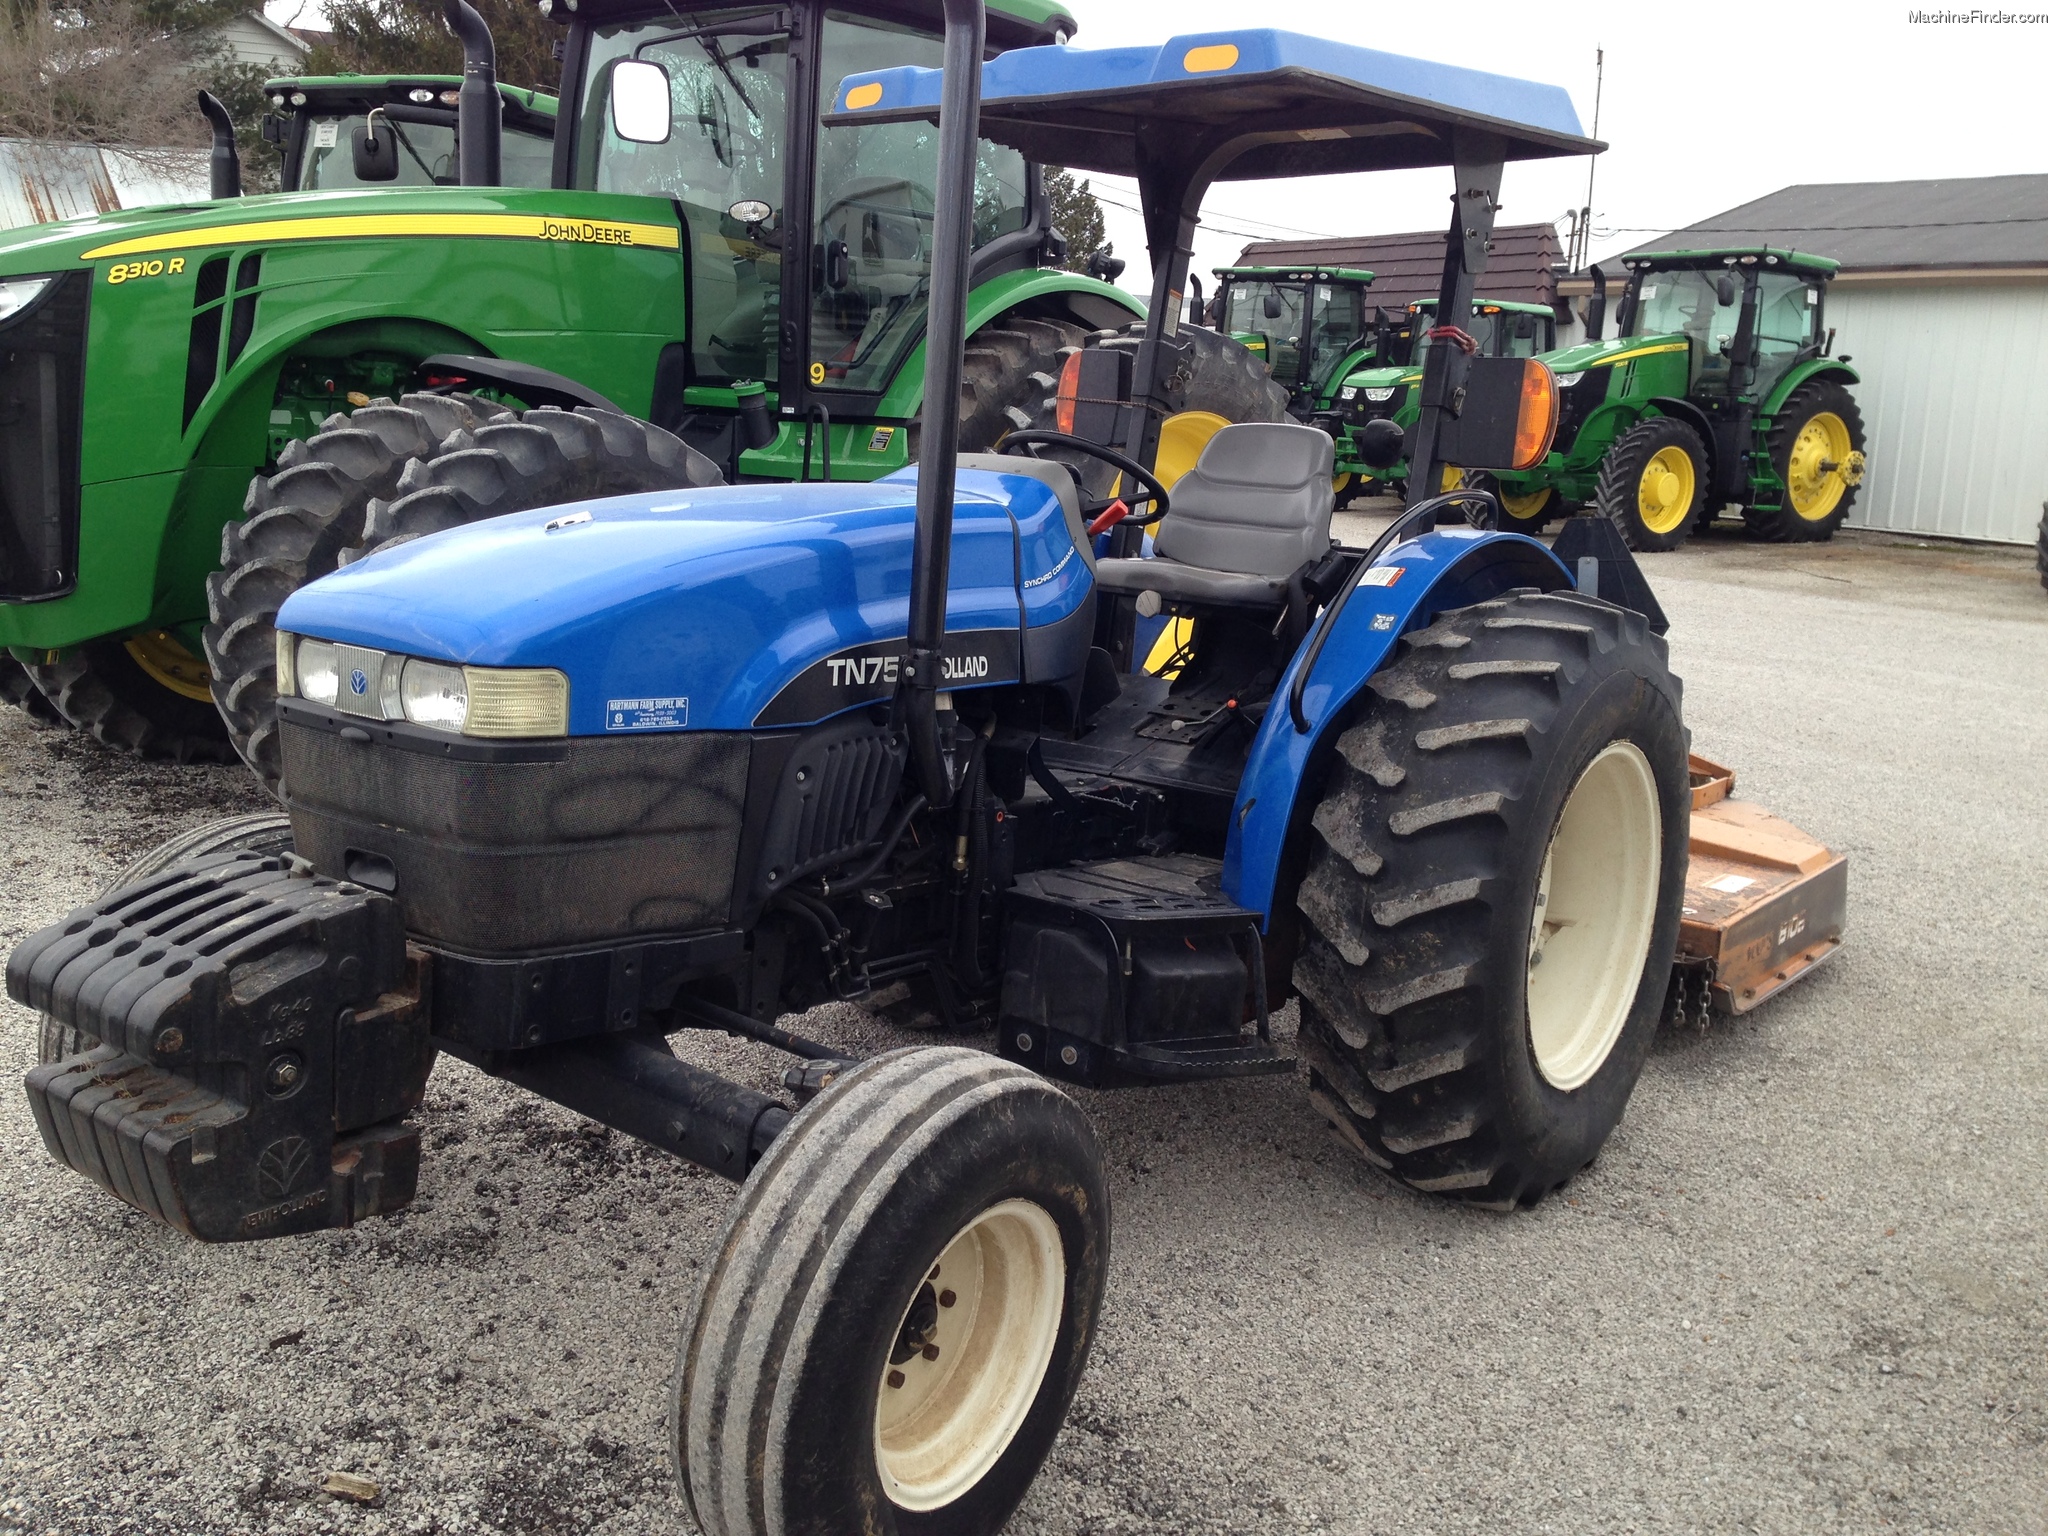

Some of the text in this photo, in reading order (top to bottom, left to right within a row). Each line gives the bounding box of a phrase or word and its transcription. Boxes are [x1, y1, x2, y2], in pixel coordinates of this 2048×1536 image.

[107, 257, 185, 284] 8310 R
[810, 362, 825, 385] 9
[1023, 545, 1075, 589] SYNCHRO COMMAND
[826, 656, 900, 687] TN75
[944, 655, 988, 680] OLLAND
[640, 700, 655, 710] FARM
